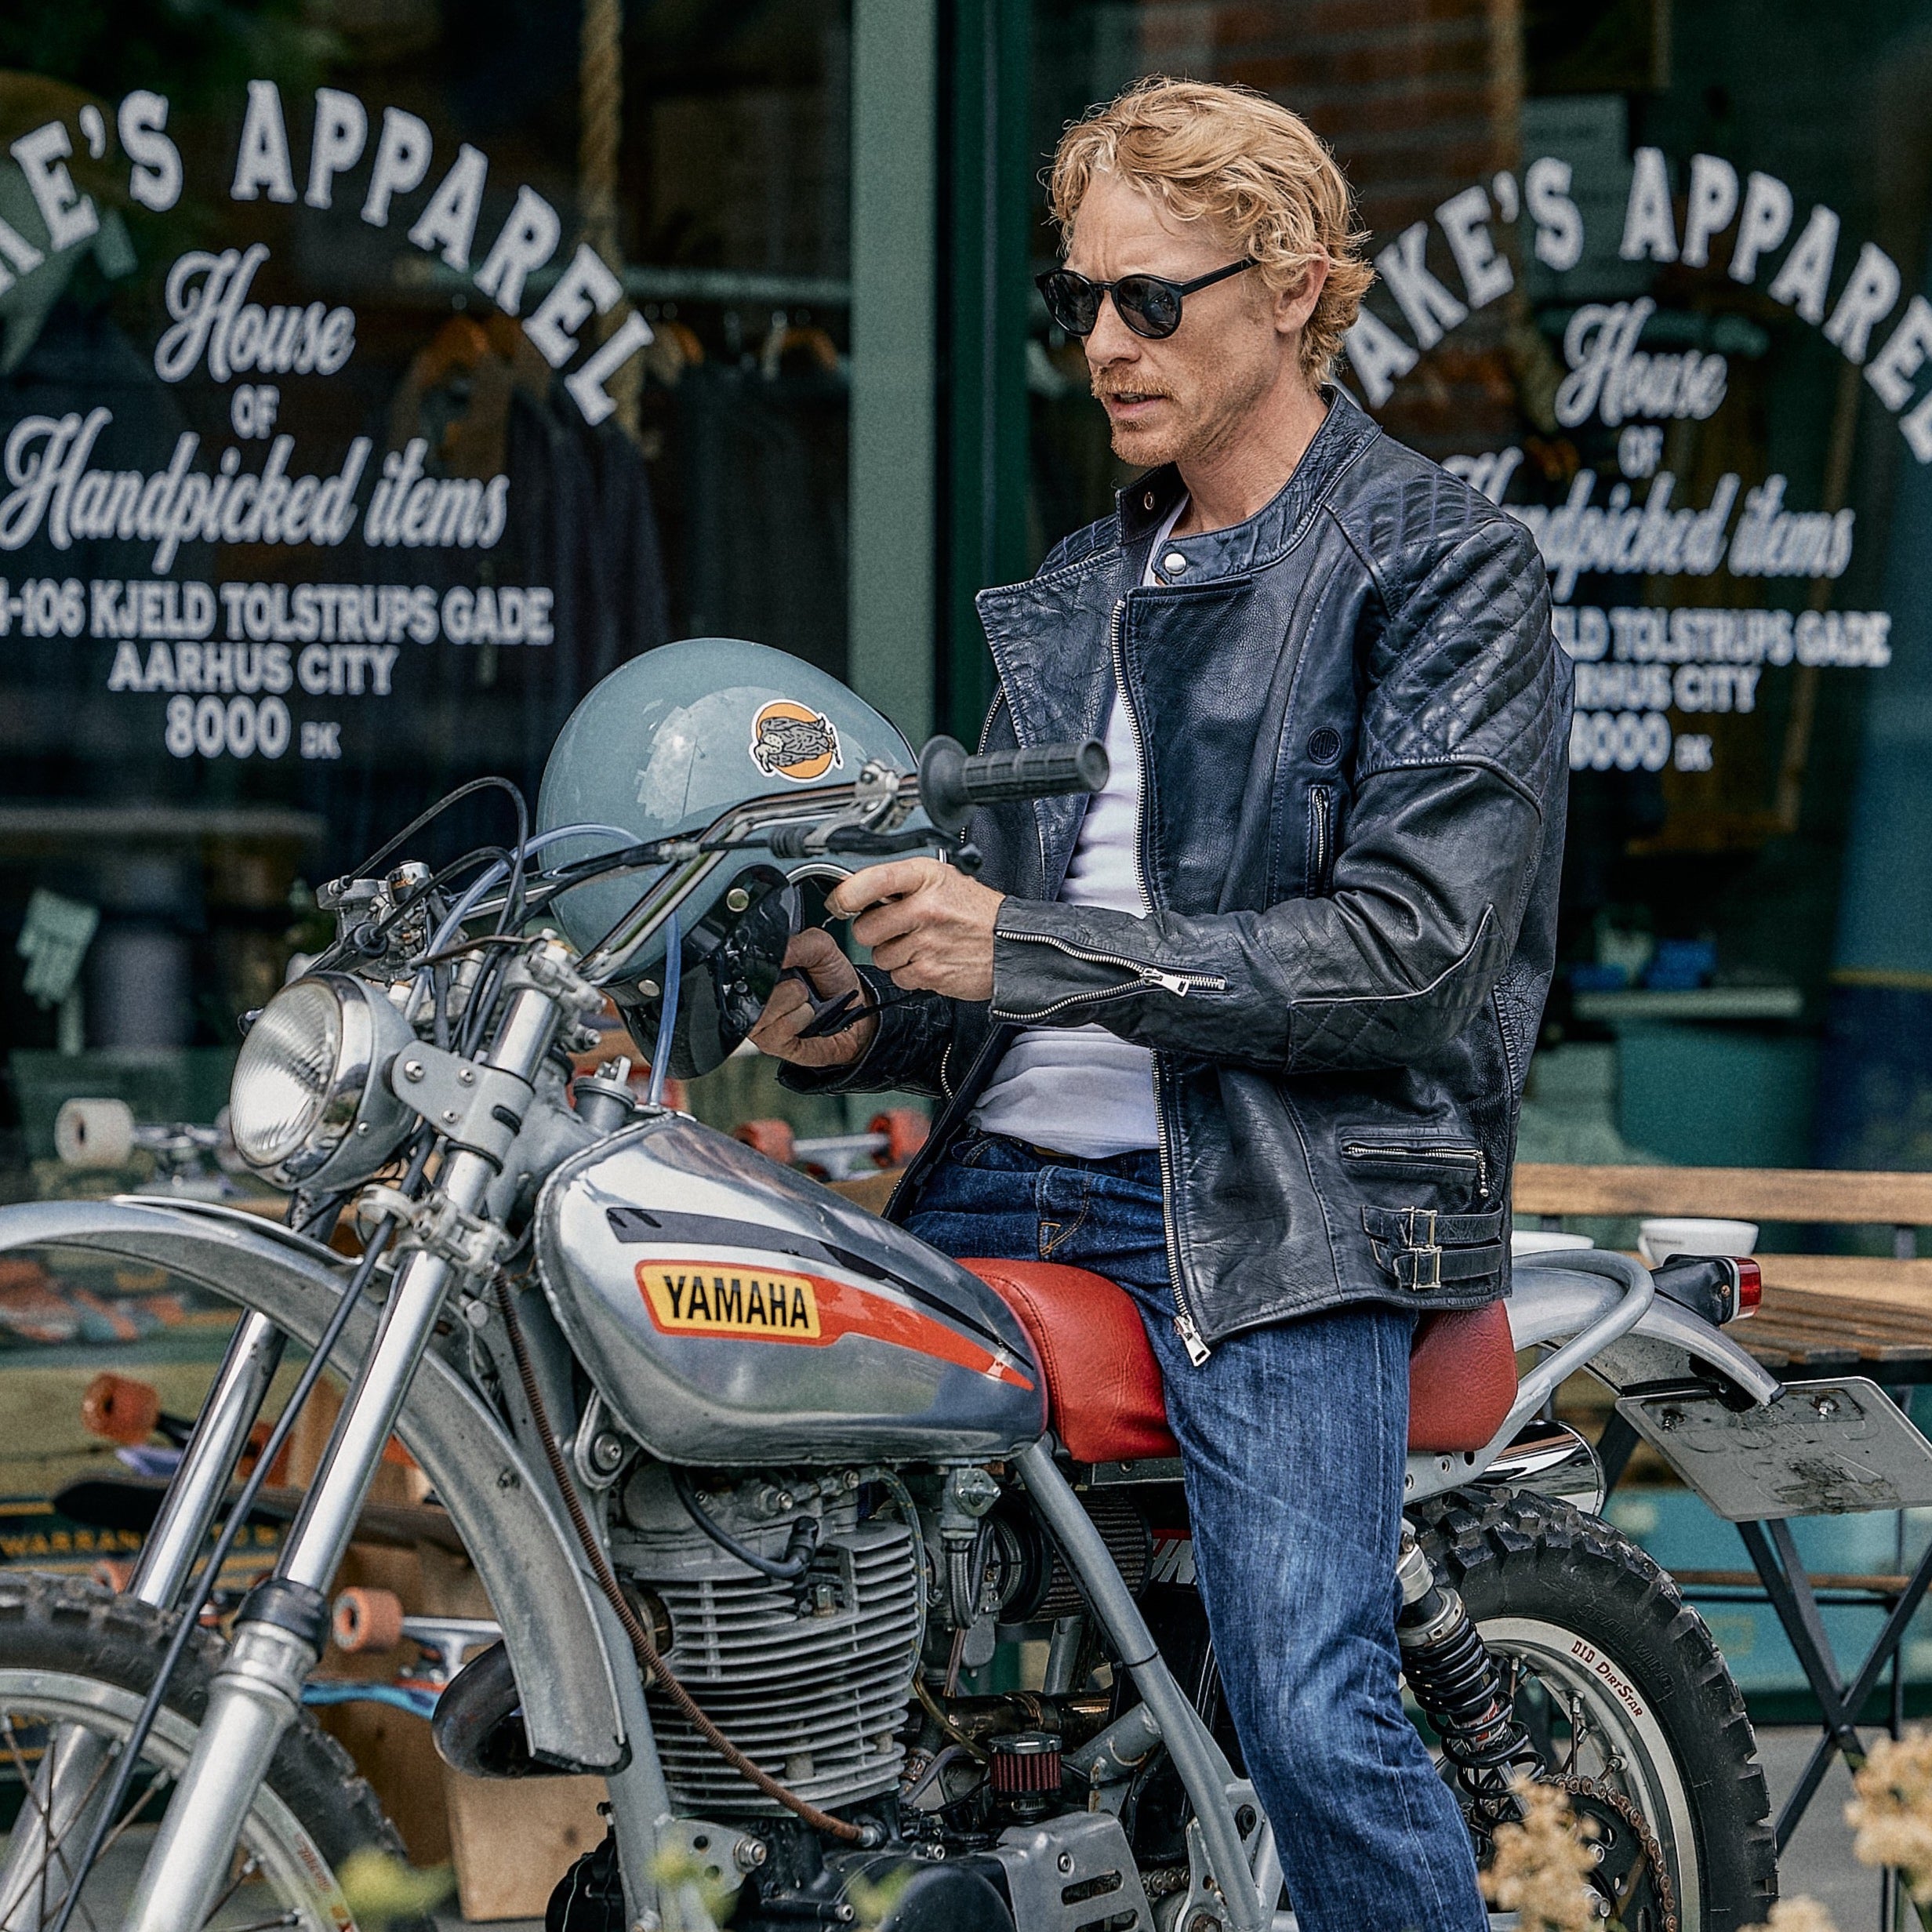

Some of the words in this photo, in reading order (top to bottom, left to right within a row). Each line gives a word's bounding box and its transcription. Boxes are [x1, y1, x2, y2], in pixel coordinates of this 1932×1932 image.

[231, 79, 655, 426] APPAREL
[1331, 157, 1584, 409] AKE'S
[154, 242, 356, 383] House
[231, 384, 280, 439] OF
[0, 406, 372, 575] Handpicked
[363, 437, 510, 548] items
[89, 579, 217, 639] KJELD
[220, 582, 439, 645] TOLSTRUPS
[441, 585, 554, 645] GADE
[107, 640, 293, 694] AARHUS
[297, 643, 399, 695] CITY
[165, 695, 292, 759] 8000
[663, 1275, 809, 1329] YAMAHA
